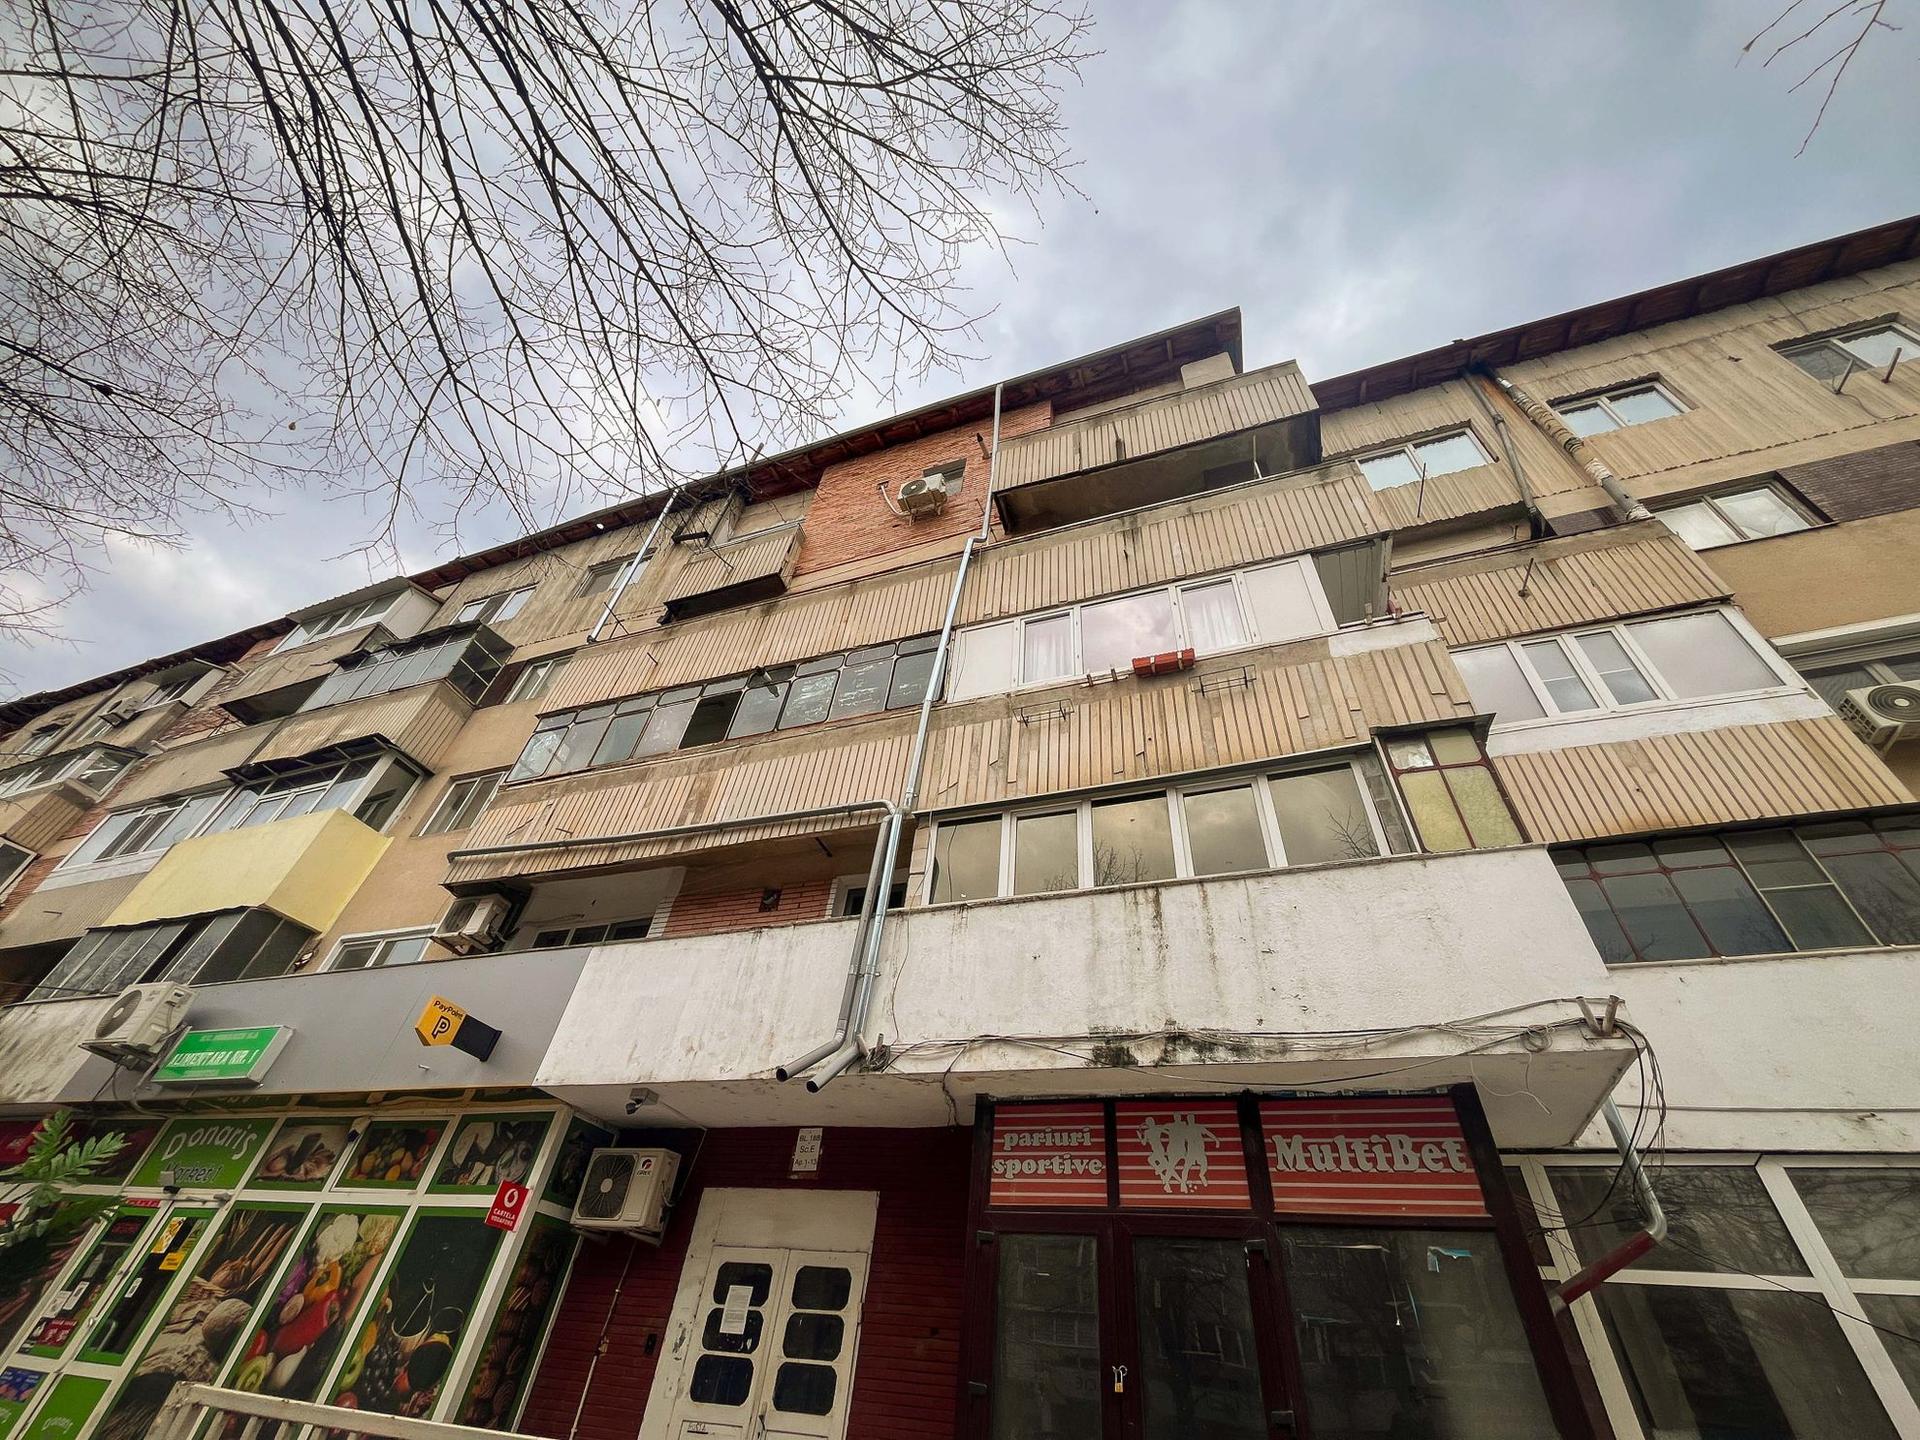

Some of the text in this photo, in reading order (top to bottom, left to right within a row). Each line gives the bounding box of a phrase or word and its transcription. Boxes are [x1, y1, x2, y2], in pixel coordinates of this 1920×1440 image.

[434, 1000, 464, 1020] PayPoint
[161, 1123, 258, 1160] Donaris
[1003, 1127, 1092, 1151] pariuri
[993, 1153, 1106, 1180] sportive
[1272, 1134, 1467, 1173] MultiBet
